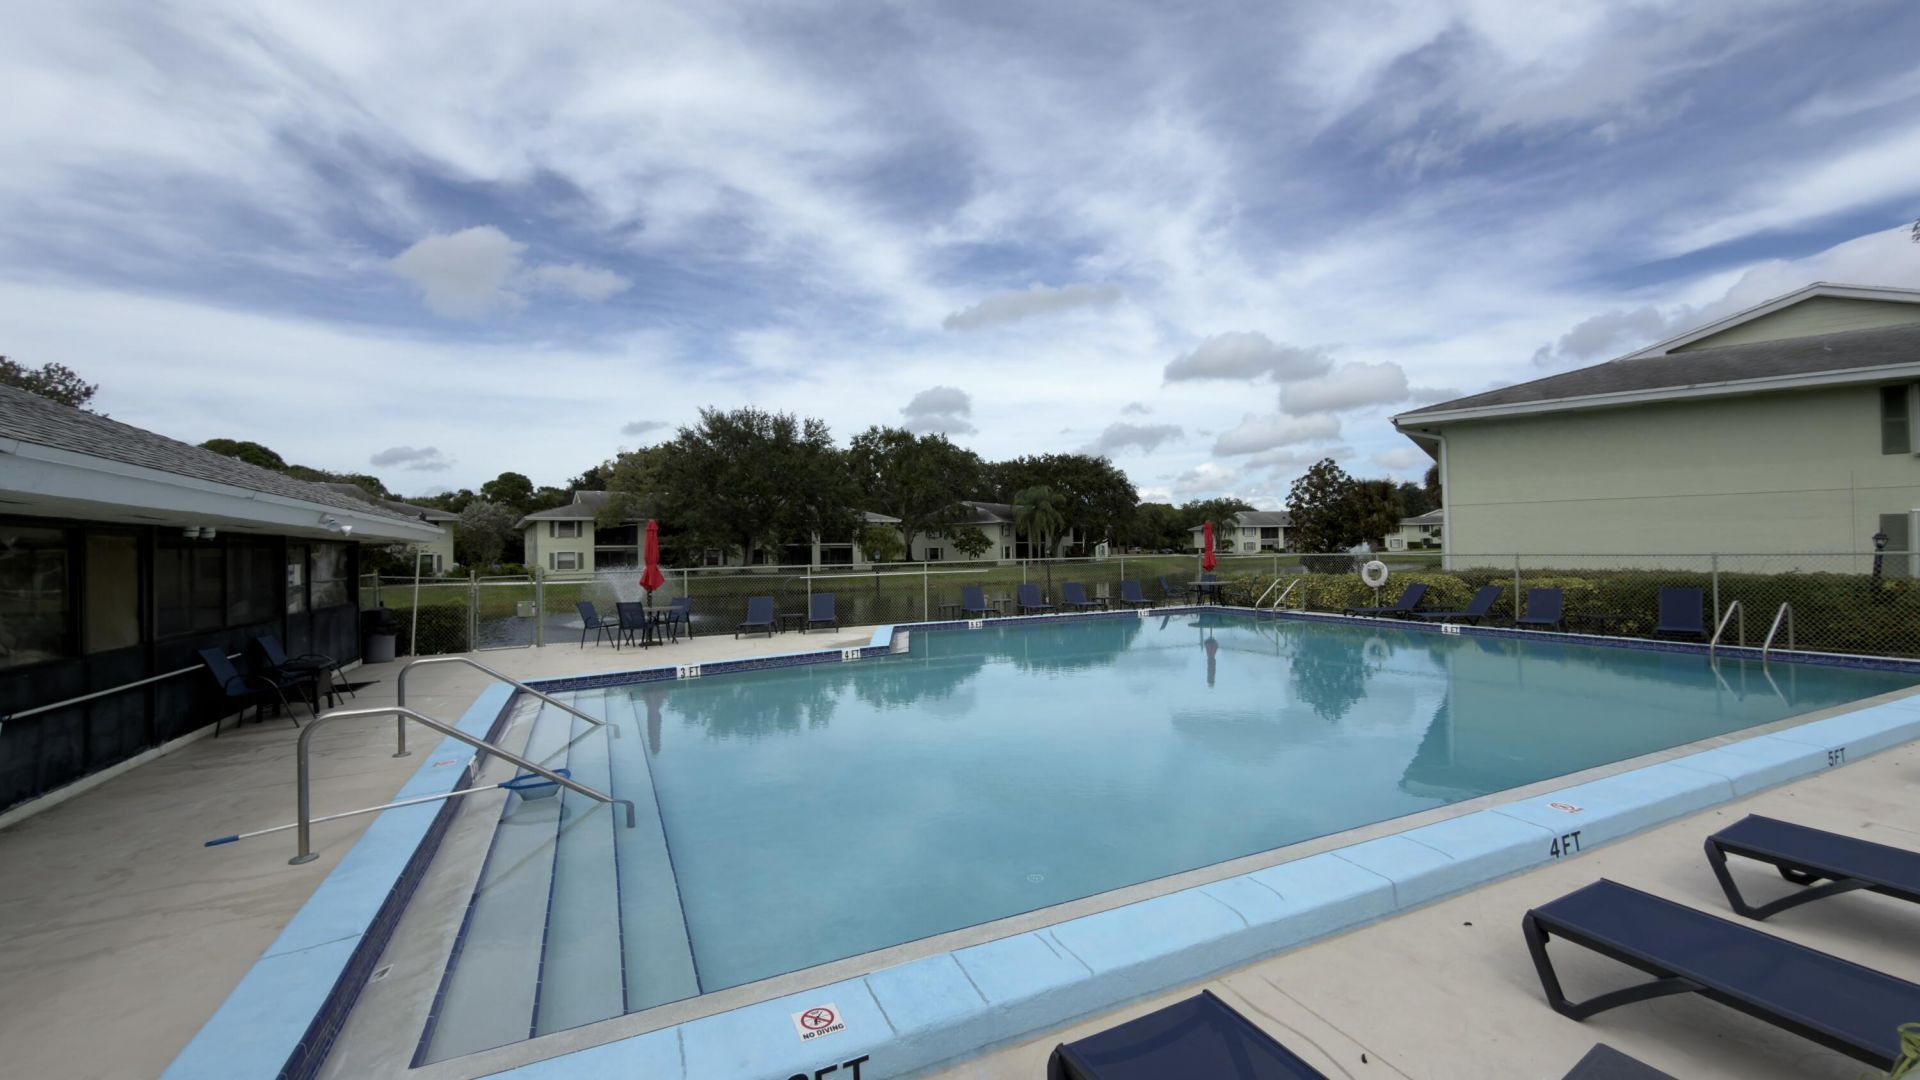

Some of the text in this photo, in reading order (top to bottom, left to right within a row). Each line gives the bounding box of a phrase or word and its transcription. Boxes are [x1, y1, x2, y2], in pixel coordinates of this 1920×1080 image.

[844, 649, 859, 661] 4 FT
[680, 665, 700, 679] 3 FT
[1828, 747, 1846, 767] 5FT
[1550, 830, 1581, 859] 4FT
[802, 1023, 845, 1040] NO DIVING
